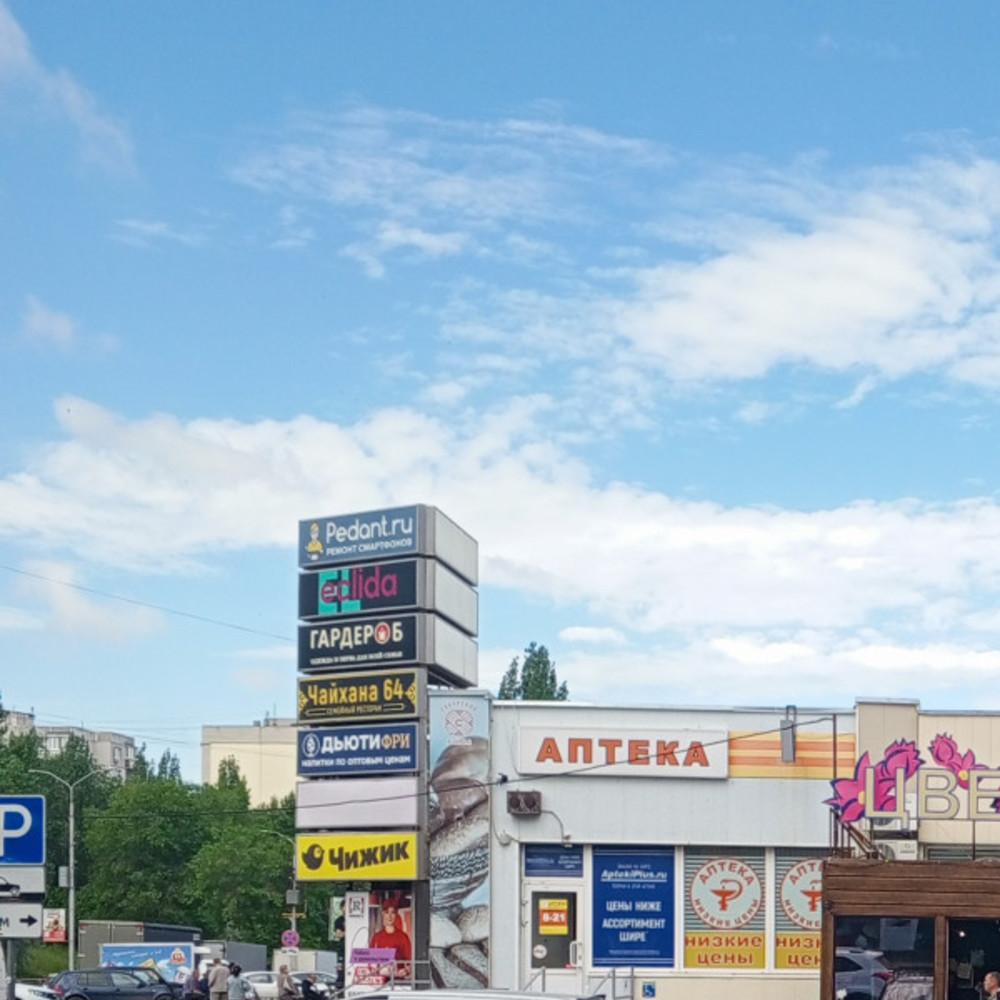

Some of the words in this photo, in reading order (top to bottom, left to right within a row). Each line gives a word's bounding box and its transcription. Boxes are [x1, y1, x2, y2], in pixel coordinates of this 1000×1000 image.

[326, 515, 413, 544] Pedant.ru
[326, 545, 357, 556] РЕМОНТ
[358, 538, 412, 552] СМАРТФОНОВ
[310, 622, 403, 650] ГАРДЕРОБ
[308, 682, 378, 705] Чайхана
[383, 679, 403, 700] 64
[535, 737, 709, 767] АПТЕКА
[0, 804, 32, 857] P
[329, 841, 409, 872] Чижик
[699, 861, 755, 886] АПТЕКА
[606, 900, 632, 912] ЦЕНЫ
[635, 900, 662, 912] НИЖЕ
[602, 918, 666, 929] АССОРТИМЕНТ
